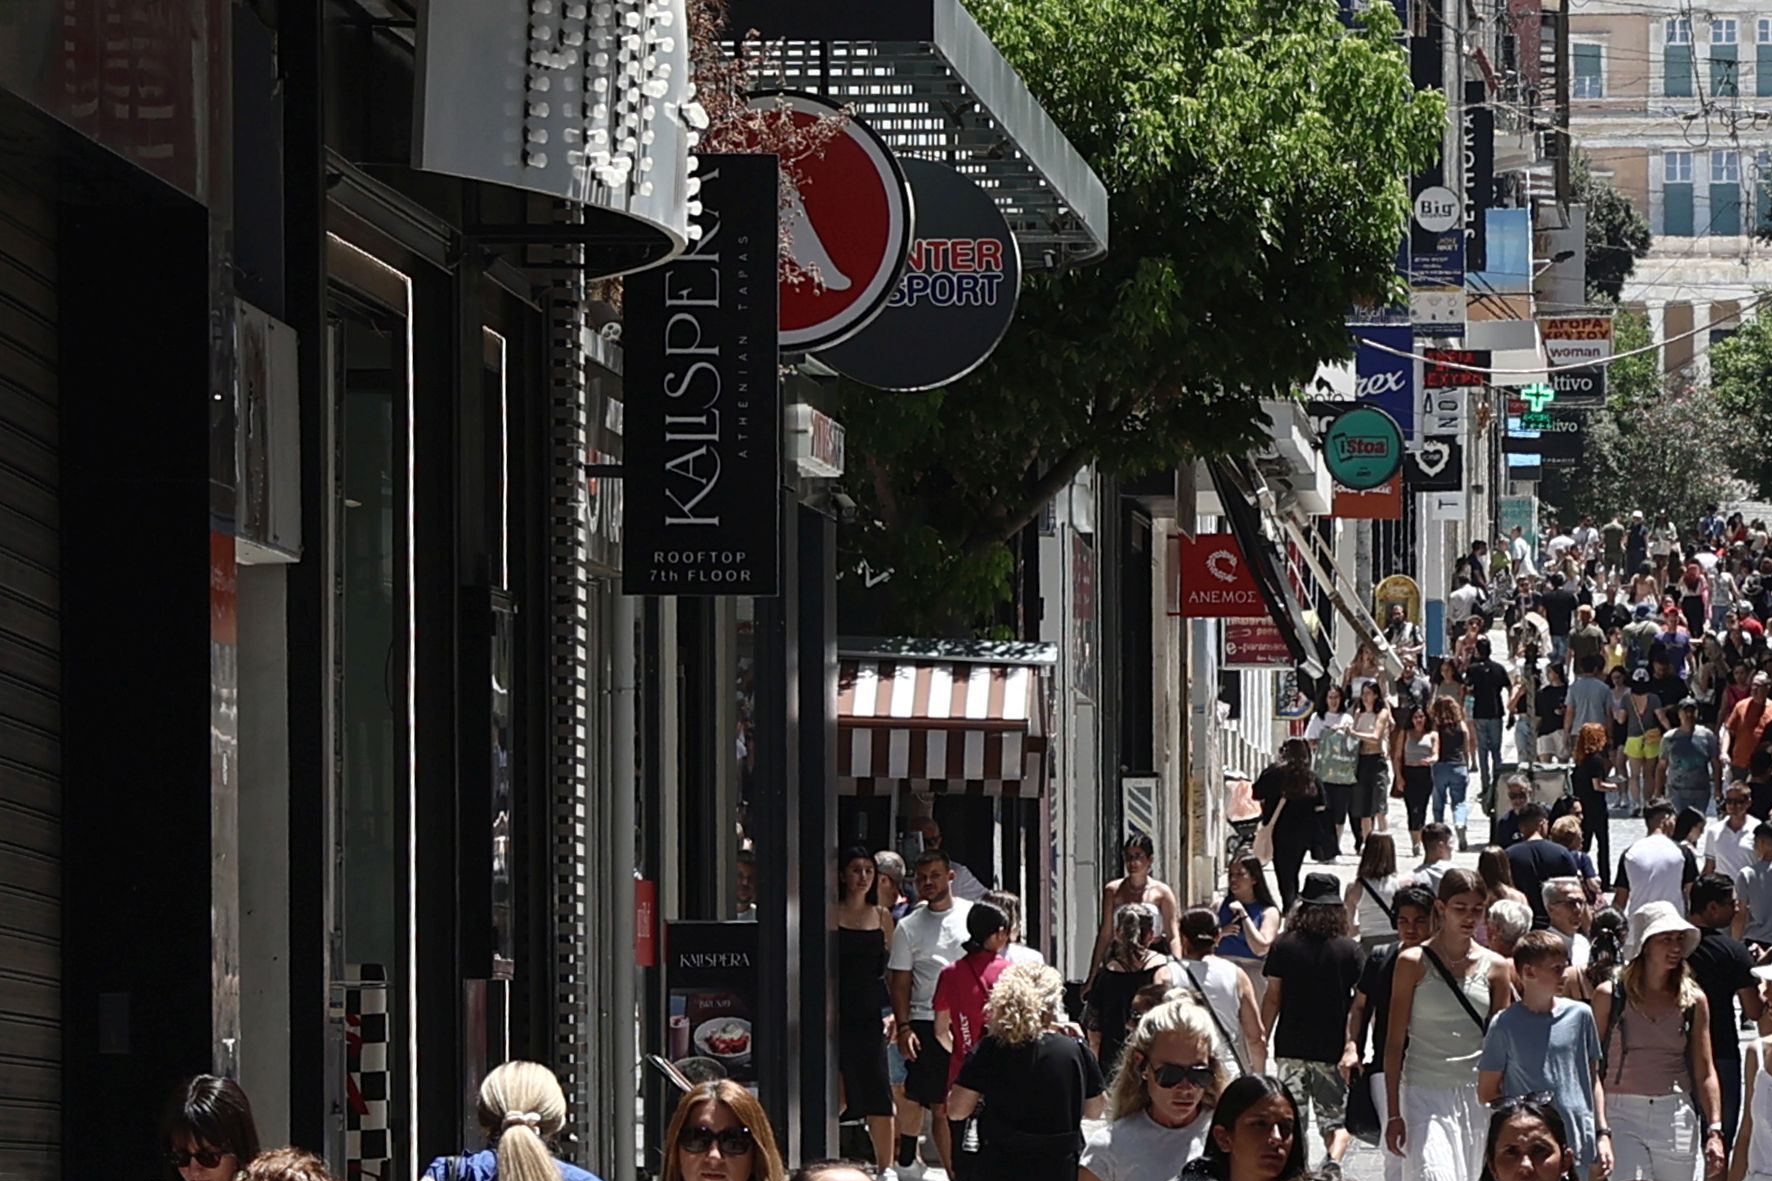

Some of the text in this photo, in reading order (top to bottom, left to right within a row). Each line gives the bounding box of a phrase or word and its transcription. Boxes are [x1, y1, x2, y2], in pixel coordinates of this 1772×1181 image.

[907, 239, 1003, 272] NTER
[1547, 318, 1604, 330] ΑΓΟΡΑ
[738, 233, 750, 459] ATHENIAN TAPAS
[1550, 346, 1601, 358] woman
[653, 550, 748, 563] ROOFTOP
[649, 569, 752, 582] 7th FLOOR
[1188, 590, 1258, 604] ΑΝΕΜΟΣ
